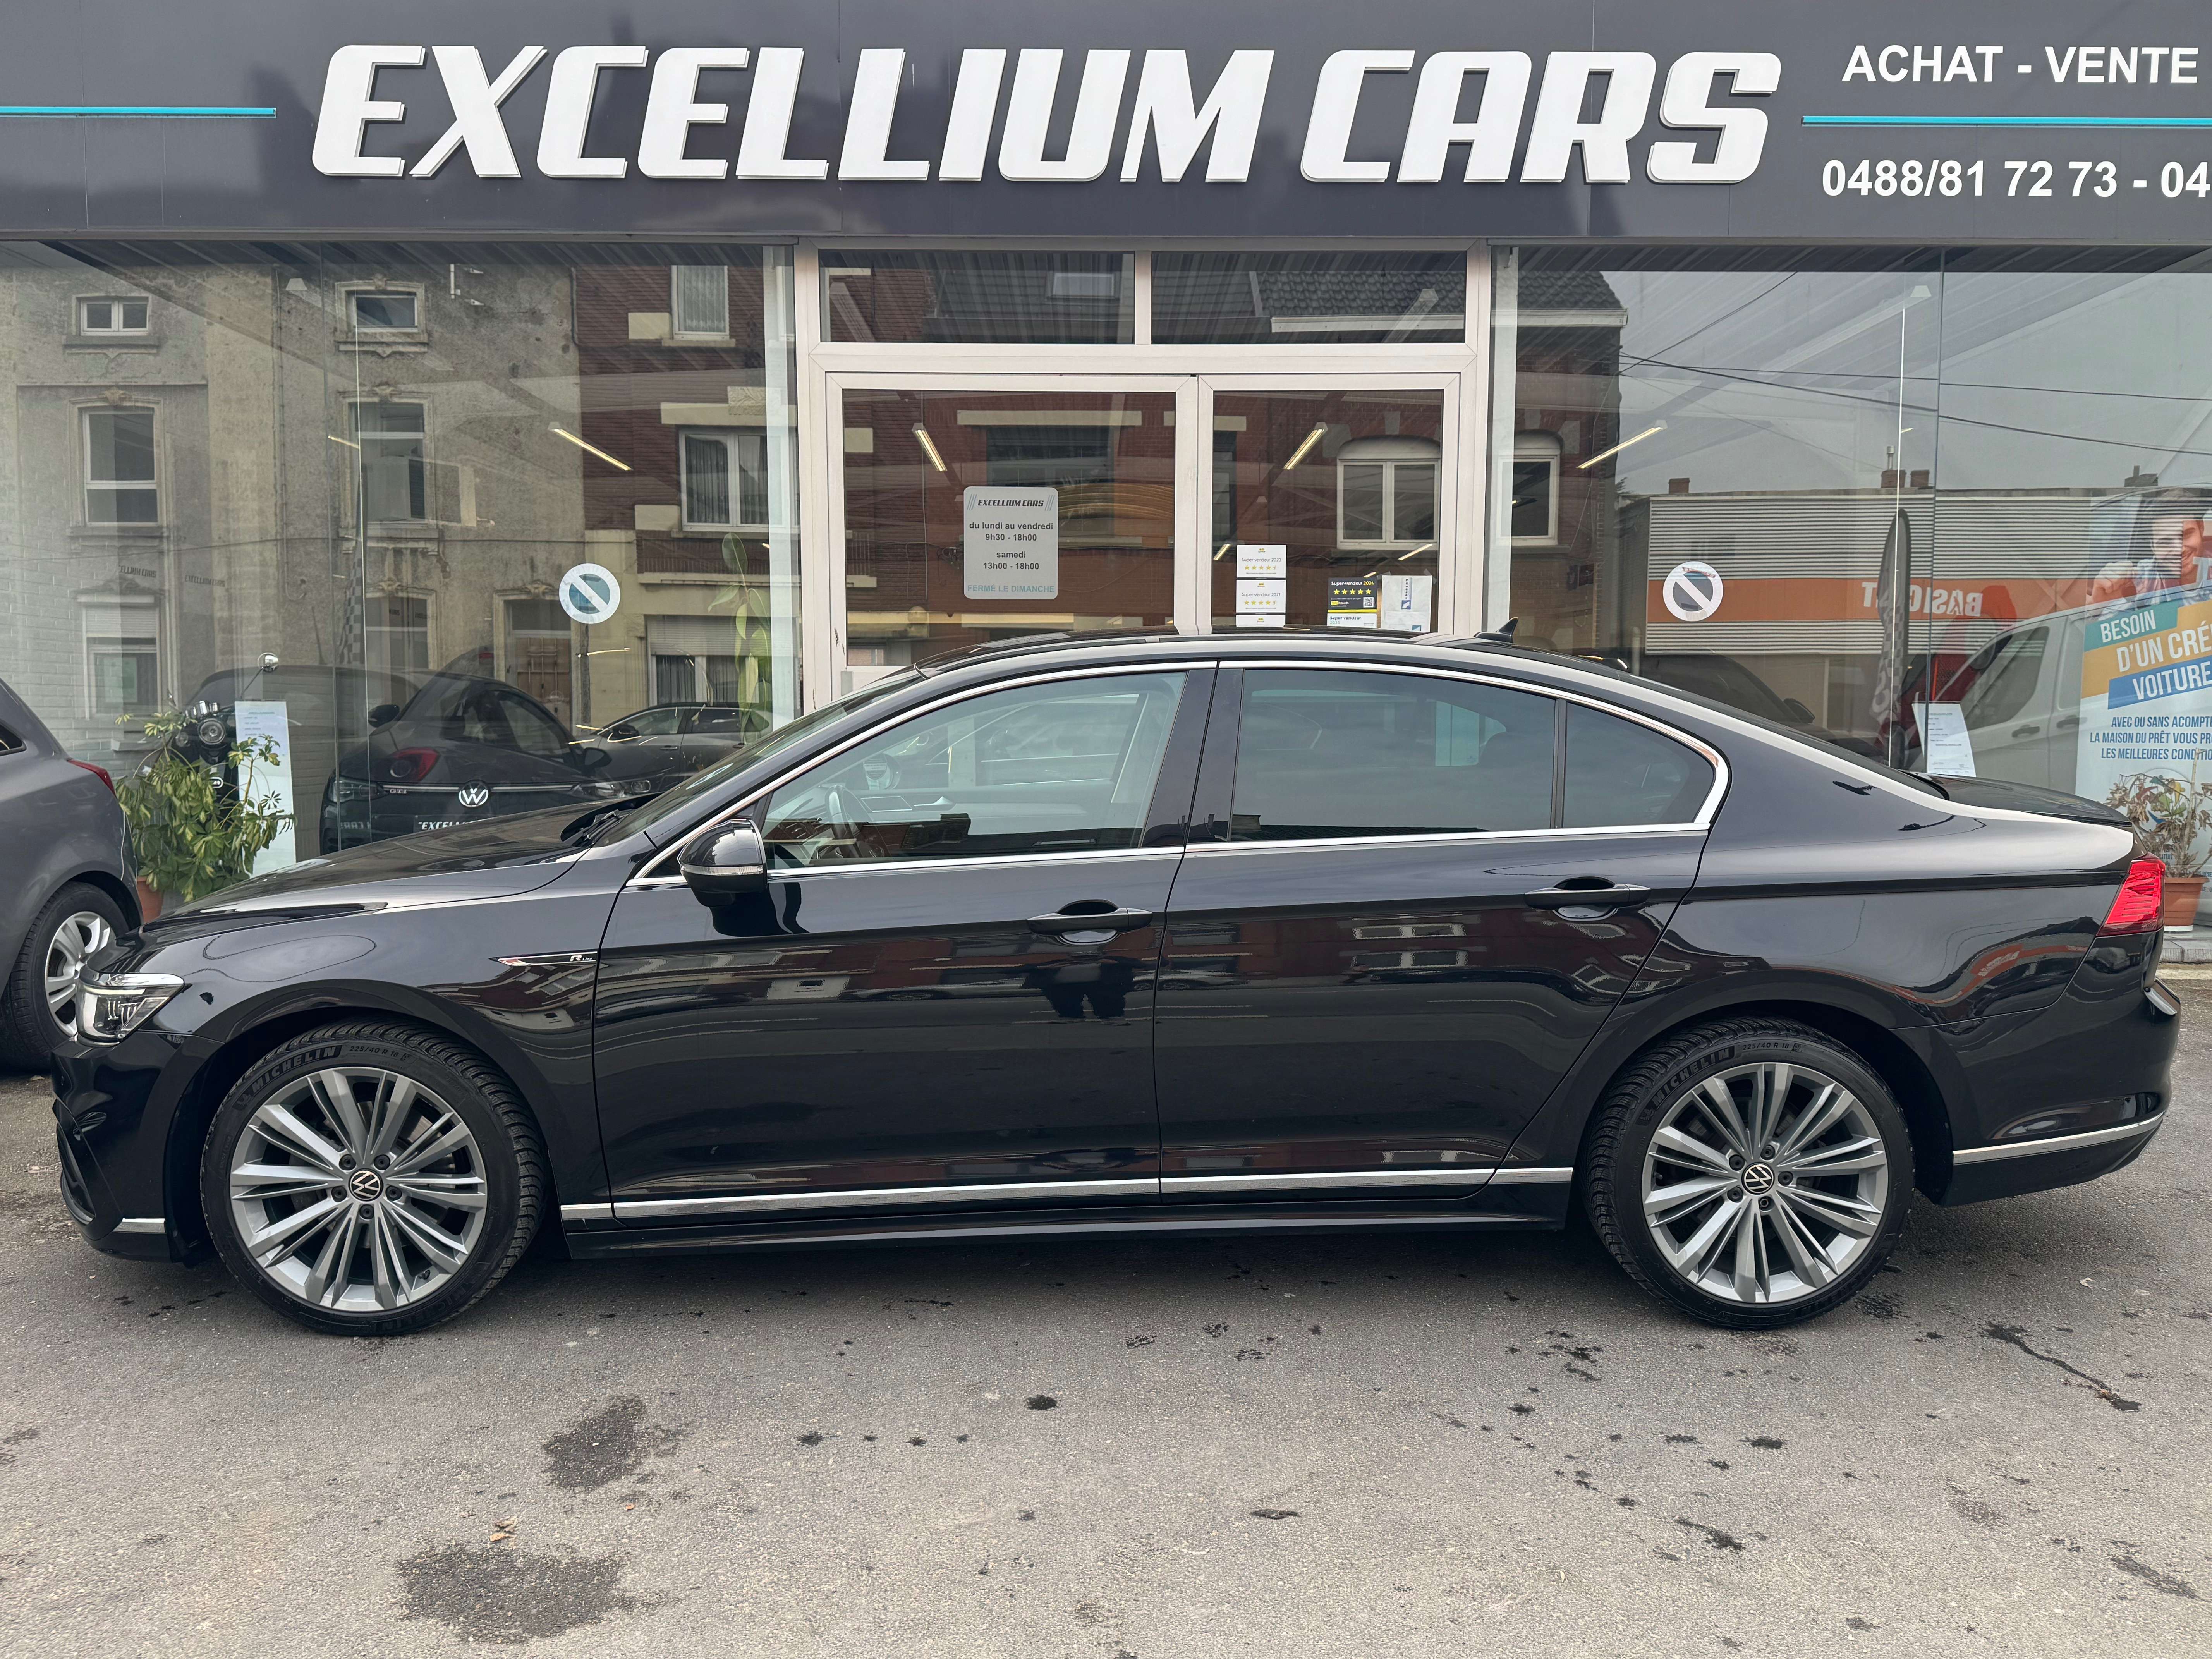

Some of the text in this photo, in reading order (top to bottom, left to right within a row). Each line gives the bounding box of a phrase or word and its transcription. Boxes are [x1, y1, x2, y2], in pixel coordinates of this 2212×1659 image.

[1842, 45, 2199, 83] ACHAT - VENTE
[312, 45, 1782, 184] EXCELLIUM CARS
[1822, 159, 1984, 196] 0488/81
[2004, 161, 2052, 196] 72
[2069, 161, 2117, 197] 73
[2160, 161, 2210, 198] 04
[2100, 610, 2156, 643] BESOIN
[2116, 620, 2212, 672] D'UN CRÉ
[2132, 661, 2212, 700] VOITURE
[2090, 730, 2212, 744] LA MAISON DU PRÊT VOUS PR
[2111, 716, 2132, 727] AVEC
[2134, 717, 2145, 727] OU
[2147, 716, 2169, 727] SANS
[2101, 748, 2116, 758] LES
[2118, 748, 2169, 759] MEILLEURES
[350, 1046, 380, 1054] 225/40
[1743, 1042, 1771, 1051] 225/40
[252, 1046, 337, 1092] MICHELIN
[1653, 1048, 1729, 1106] MICHELIN
